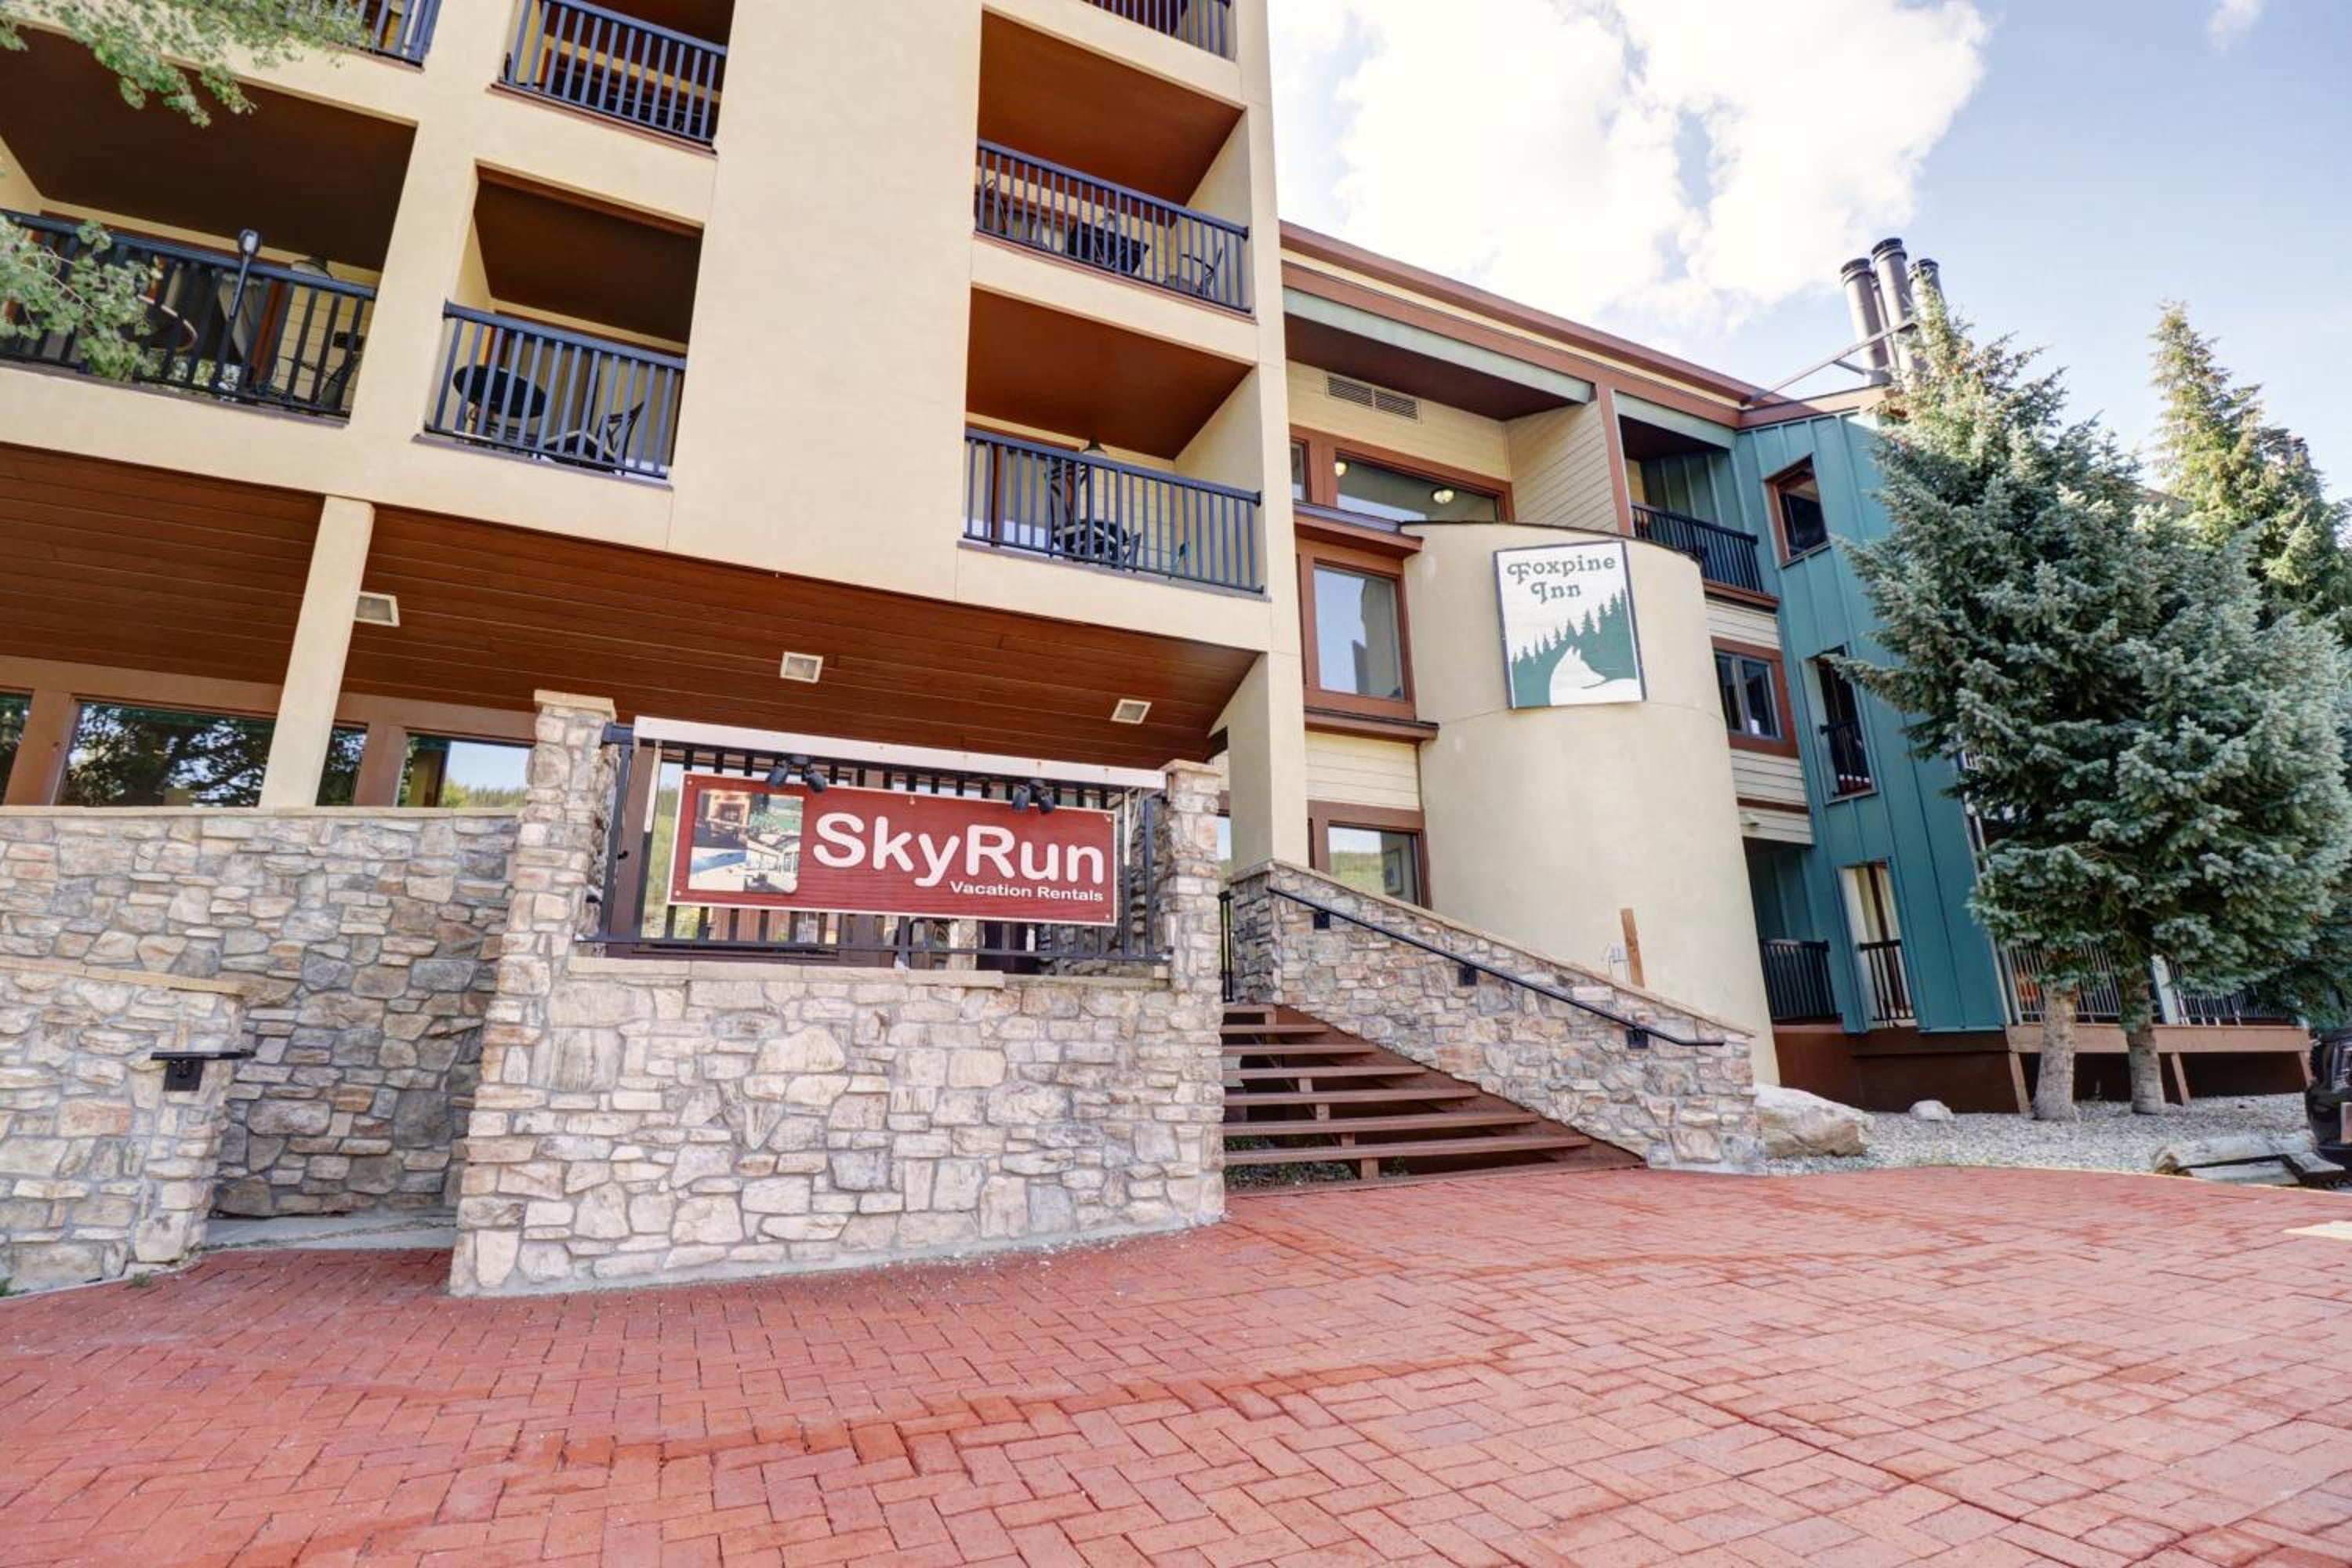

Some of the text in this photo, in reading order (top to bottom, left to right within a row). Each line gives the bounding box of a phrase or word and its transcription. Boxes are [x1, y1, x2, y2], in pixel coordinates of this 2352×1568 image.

[1507, 555, 1616, 584] Foxpine
[1530, 582, 1581, 604] Inn
[813, 812, 1104, 887] SkyRun
[949, 880, 1104, 902] Vacation Rentals
